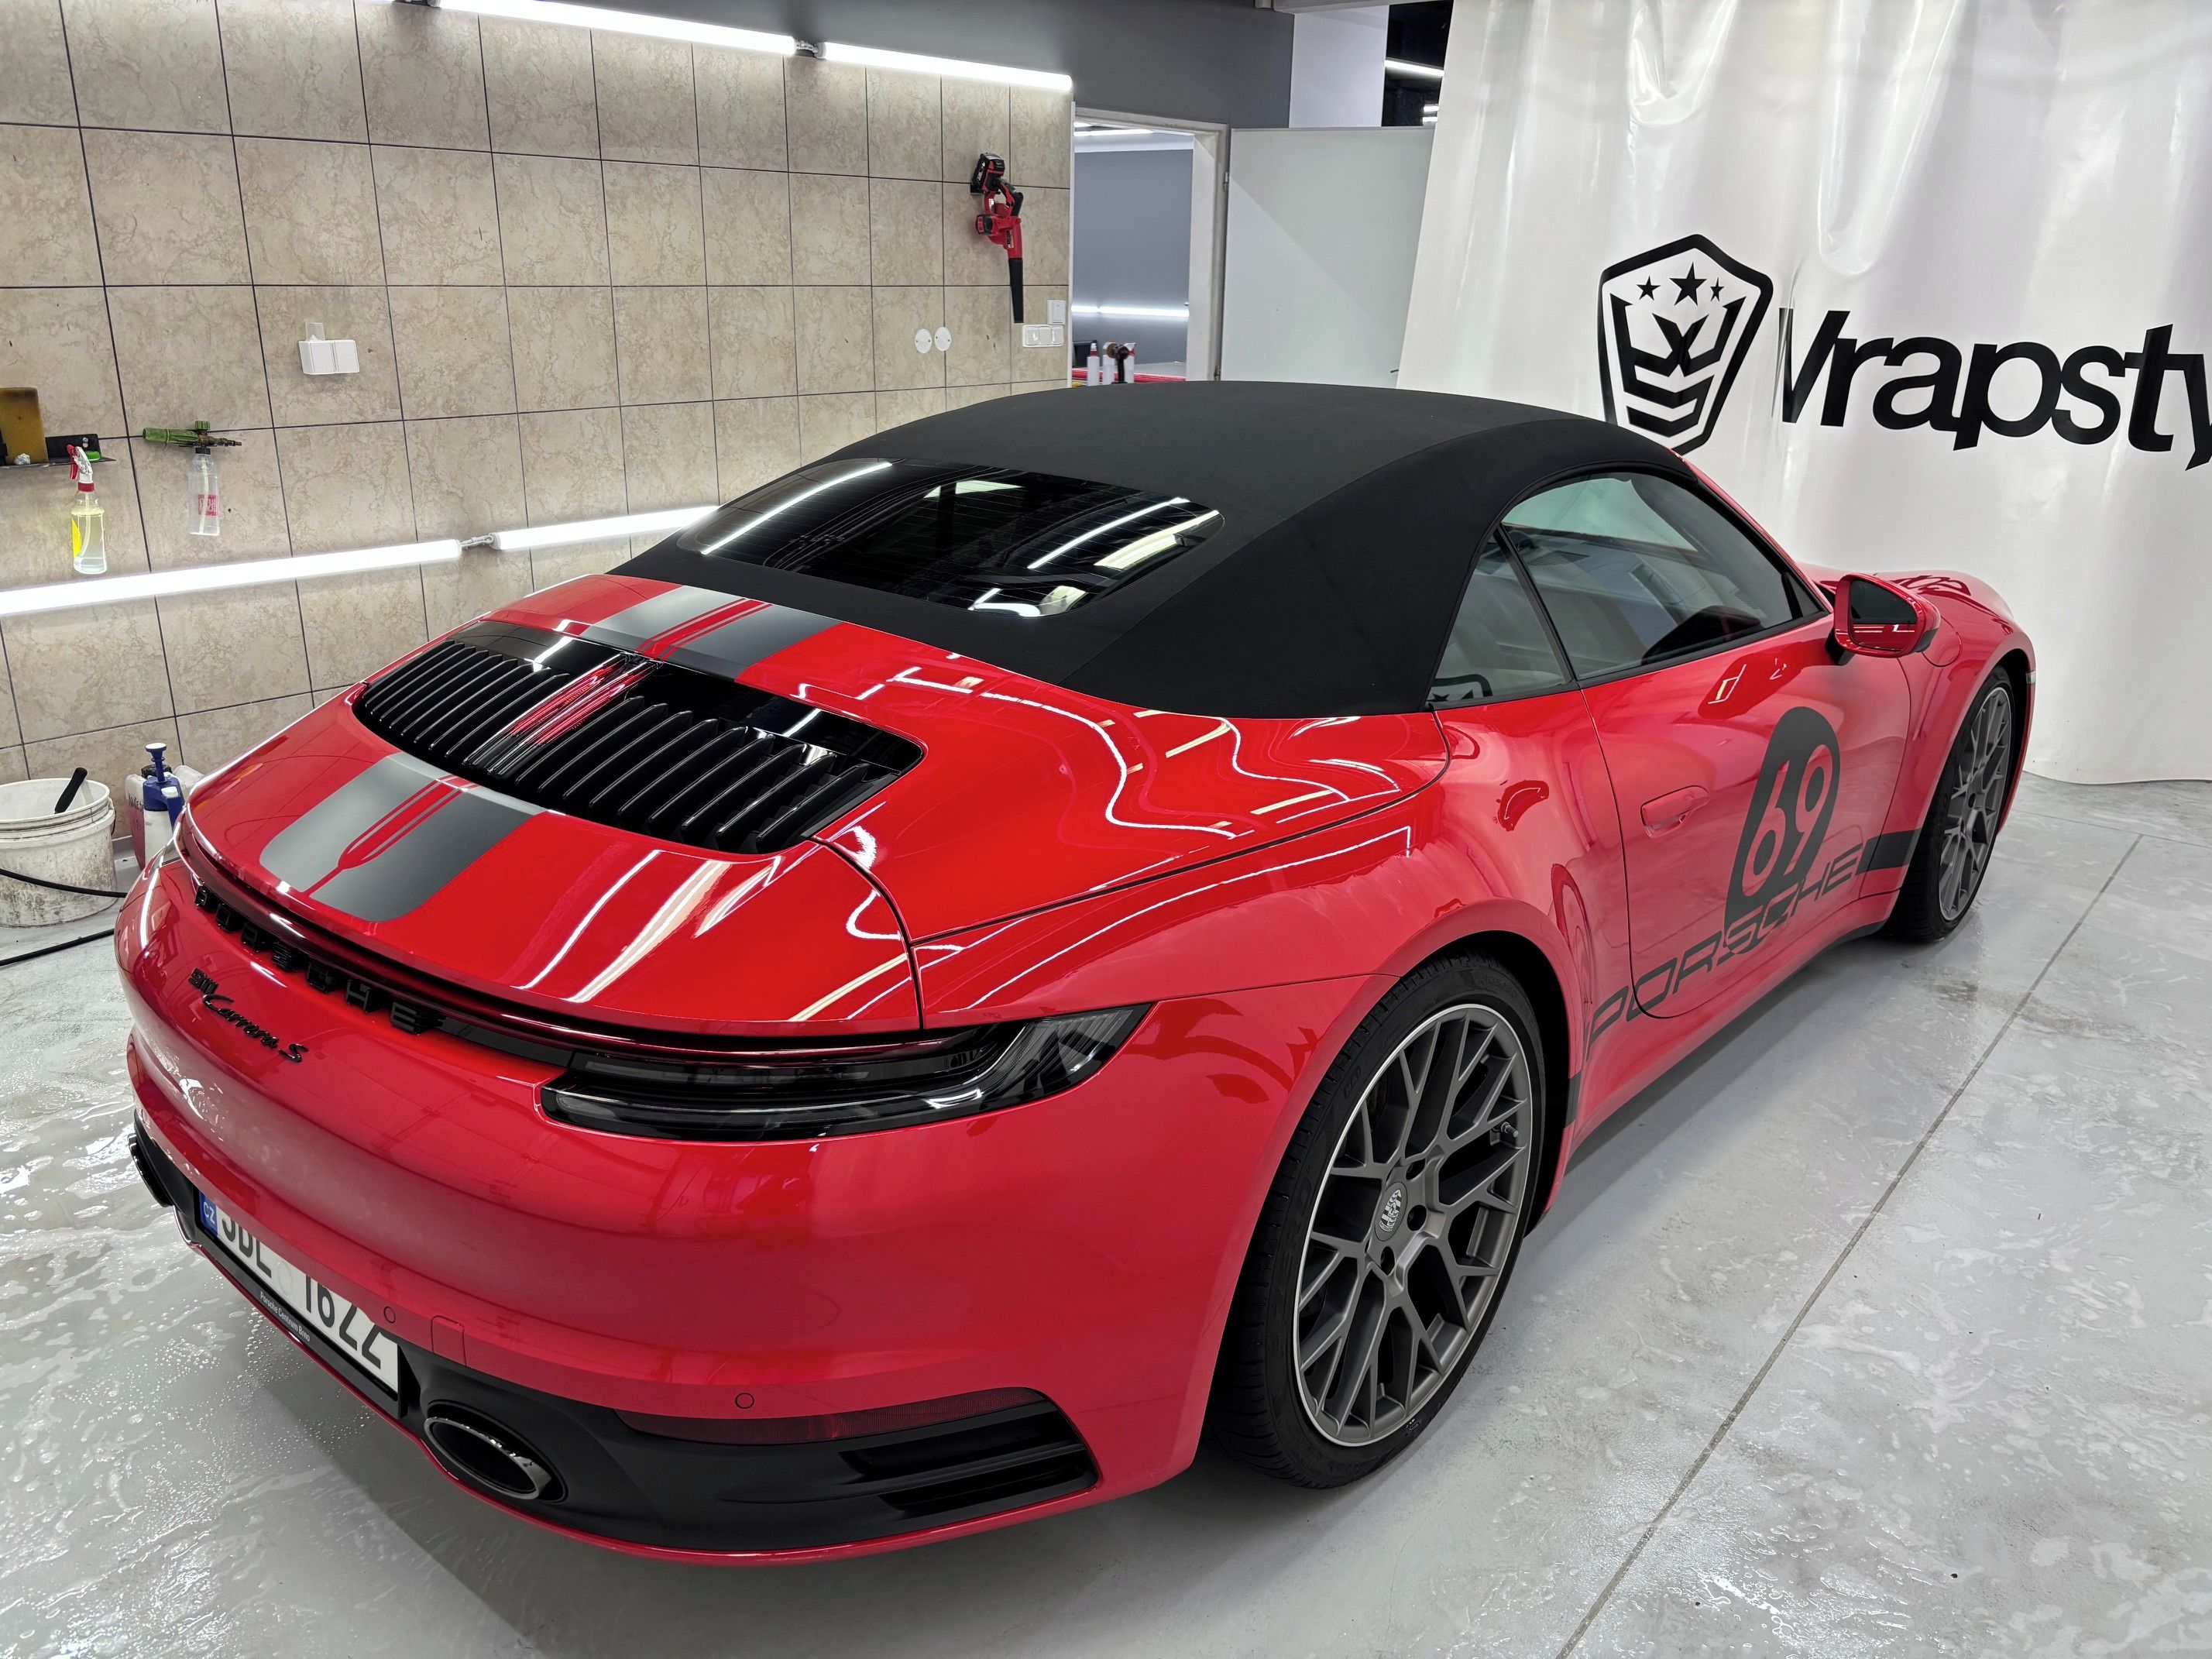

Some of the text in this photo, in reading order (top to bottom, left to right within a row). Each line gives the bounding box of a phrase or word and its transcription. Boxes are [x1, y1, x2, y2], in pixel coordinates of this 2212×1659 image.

[1741, 744, 1833, 898] 69
[1585, 843, 1864, 1061] PORSCHE
[278, 1043, 308, 1063] S
[203, 1201, 215, 1224] CZ
[260, 1291, 310, 1342] Porsche Centrum Brno
